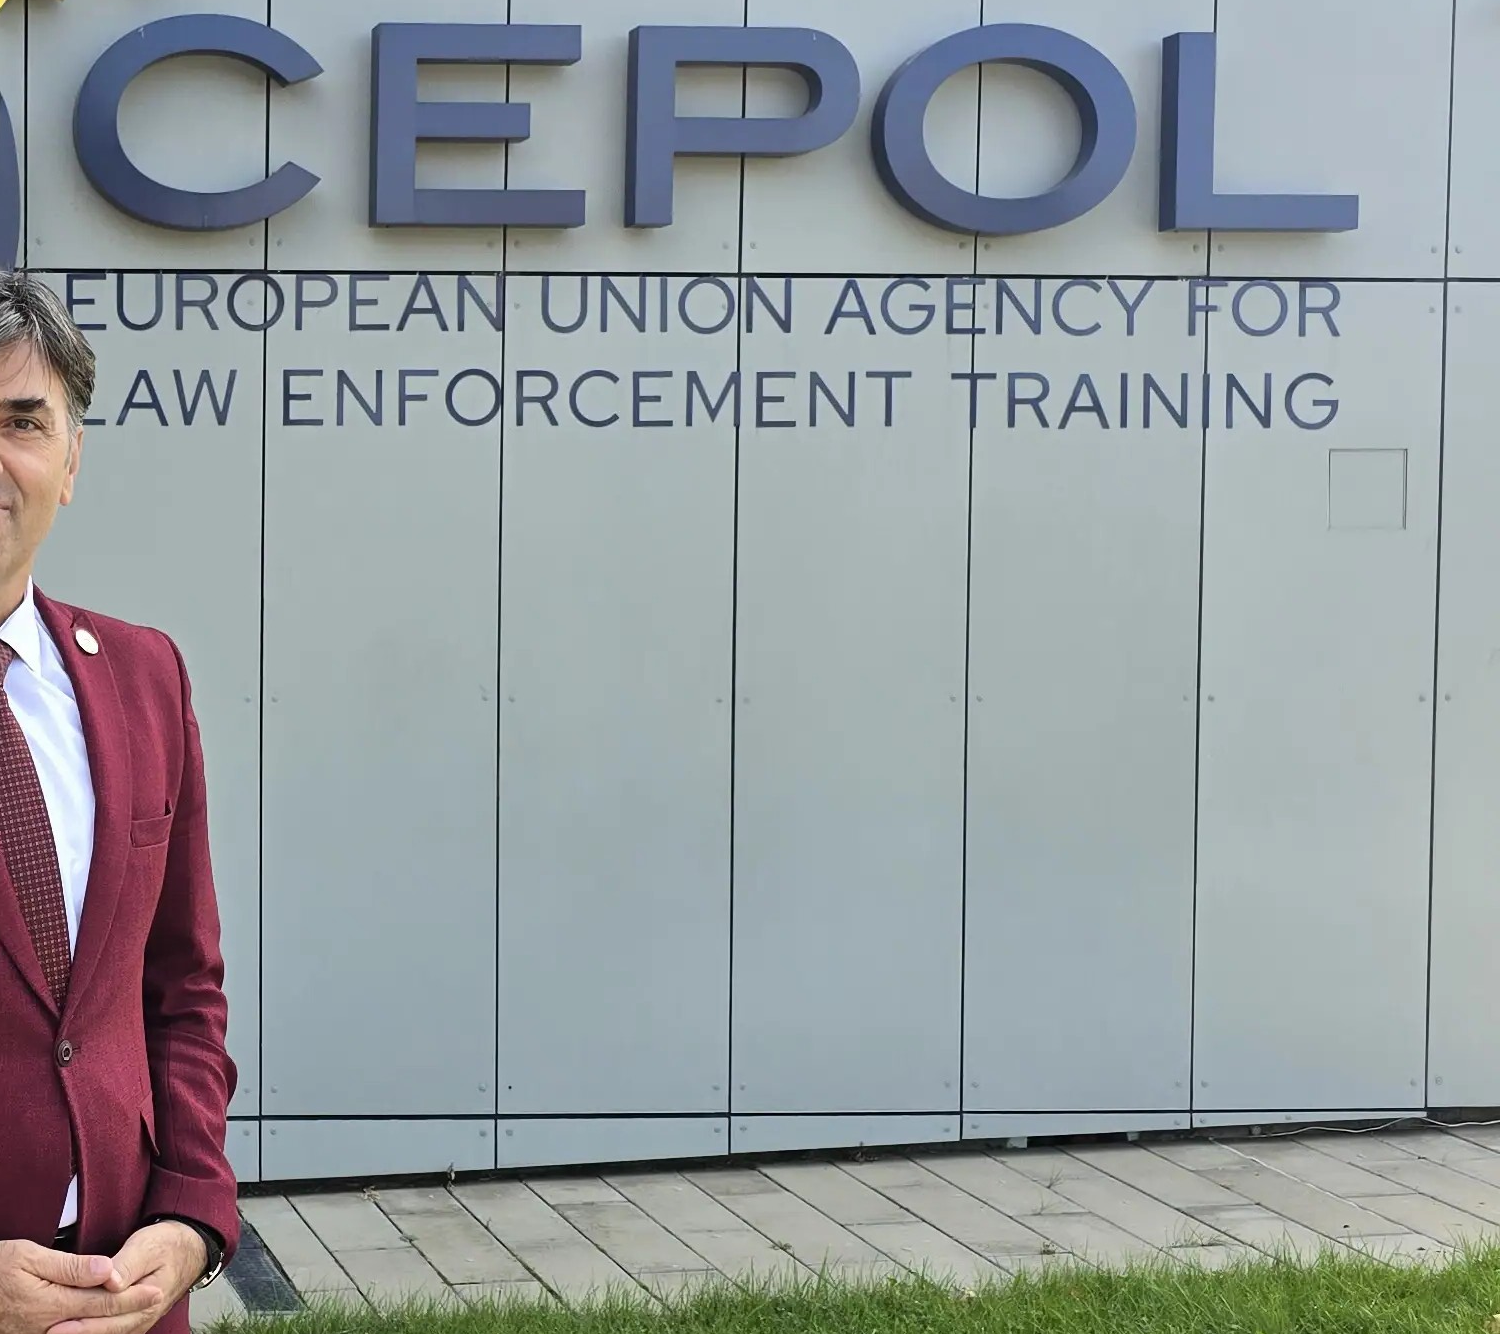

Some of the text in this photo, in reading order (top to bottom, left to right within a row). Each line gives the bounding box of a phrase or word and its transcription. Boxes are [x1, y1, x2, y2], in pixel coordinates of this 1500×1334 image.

[72, 13, 1359, 236] CEPOL
[66, 273, 1341, 338] EUROPEAN UNION AGENCY FOR
[282, 368, 912, 428] ENFORCEMENT
[951, 371, 1339, 431] TRAINING
